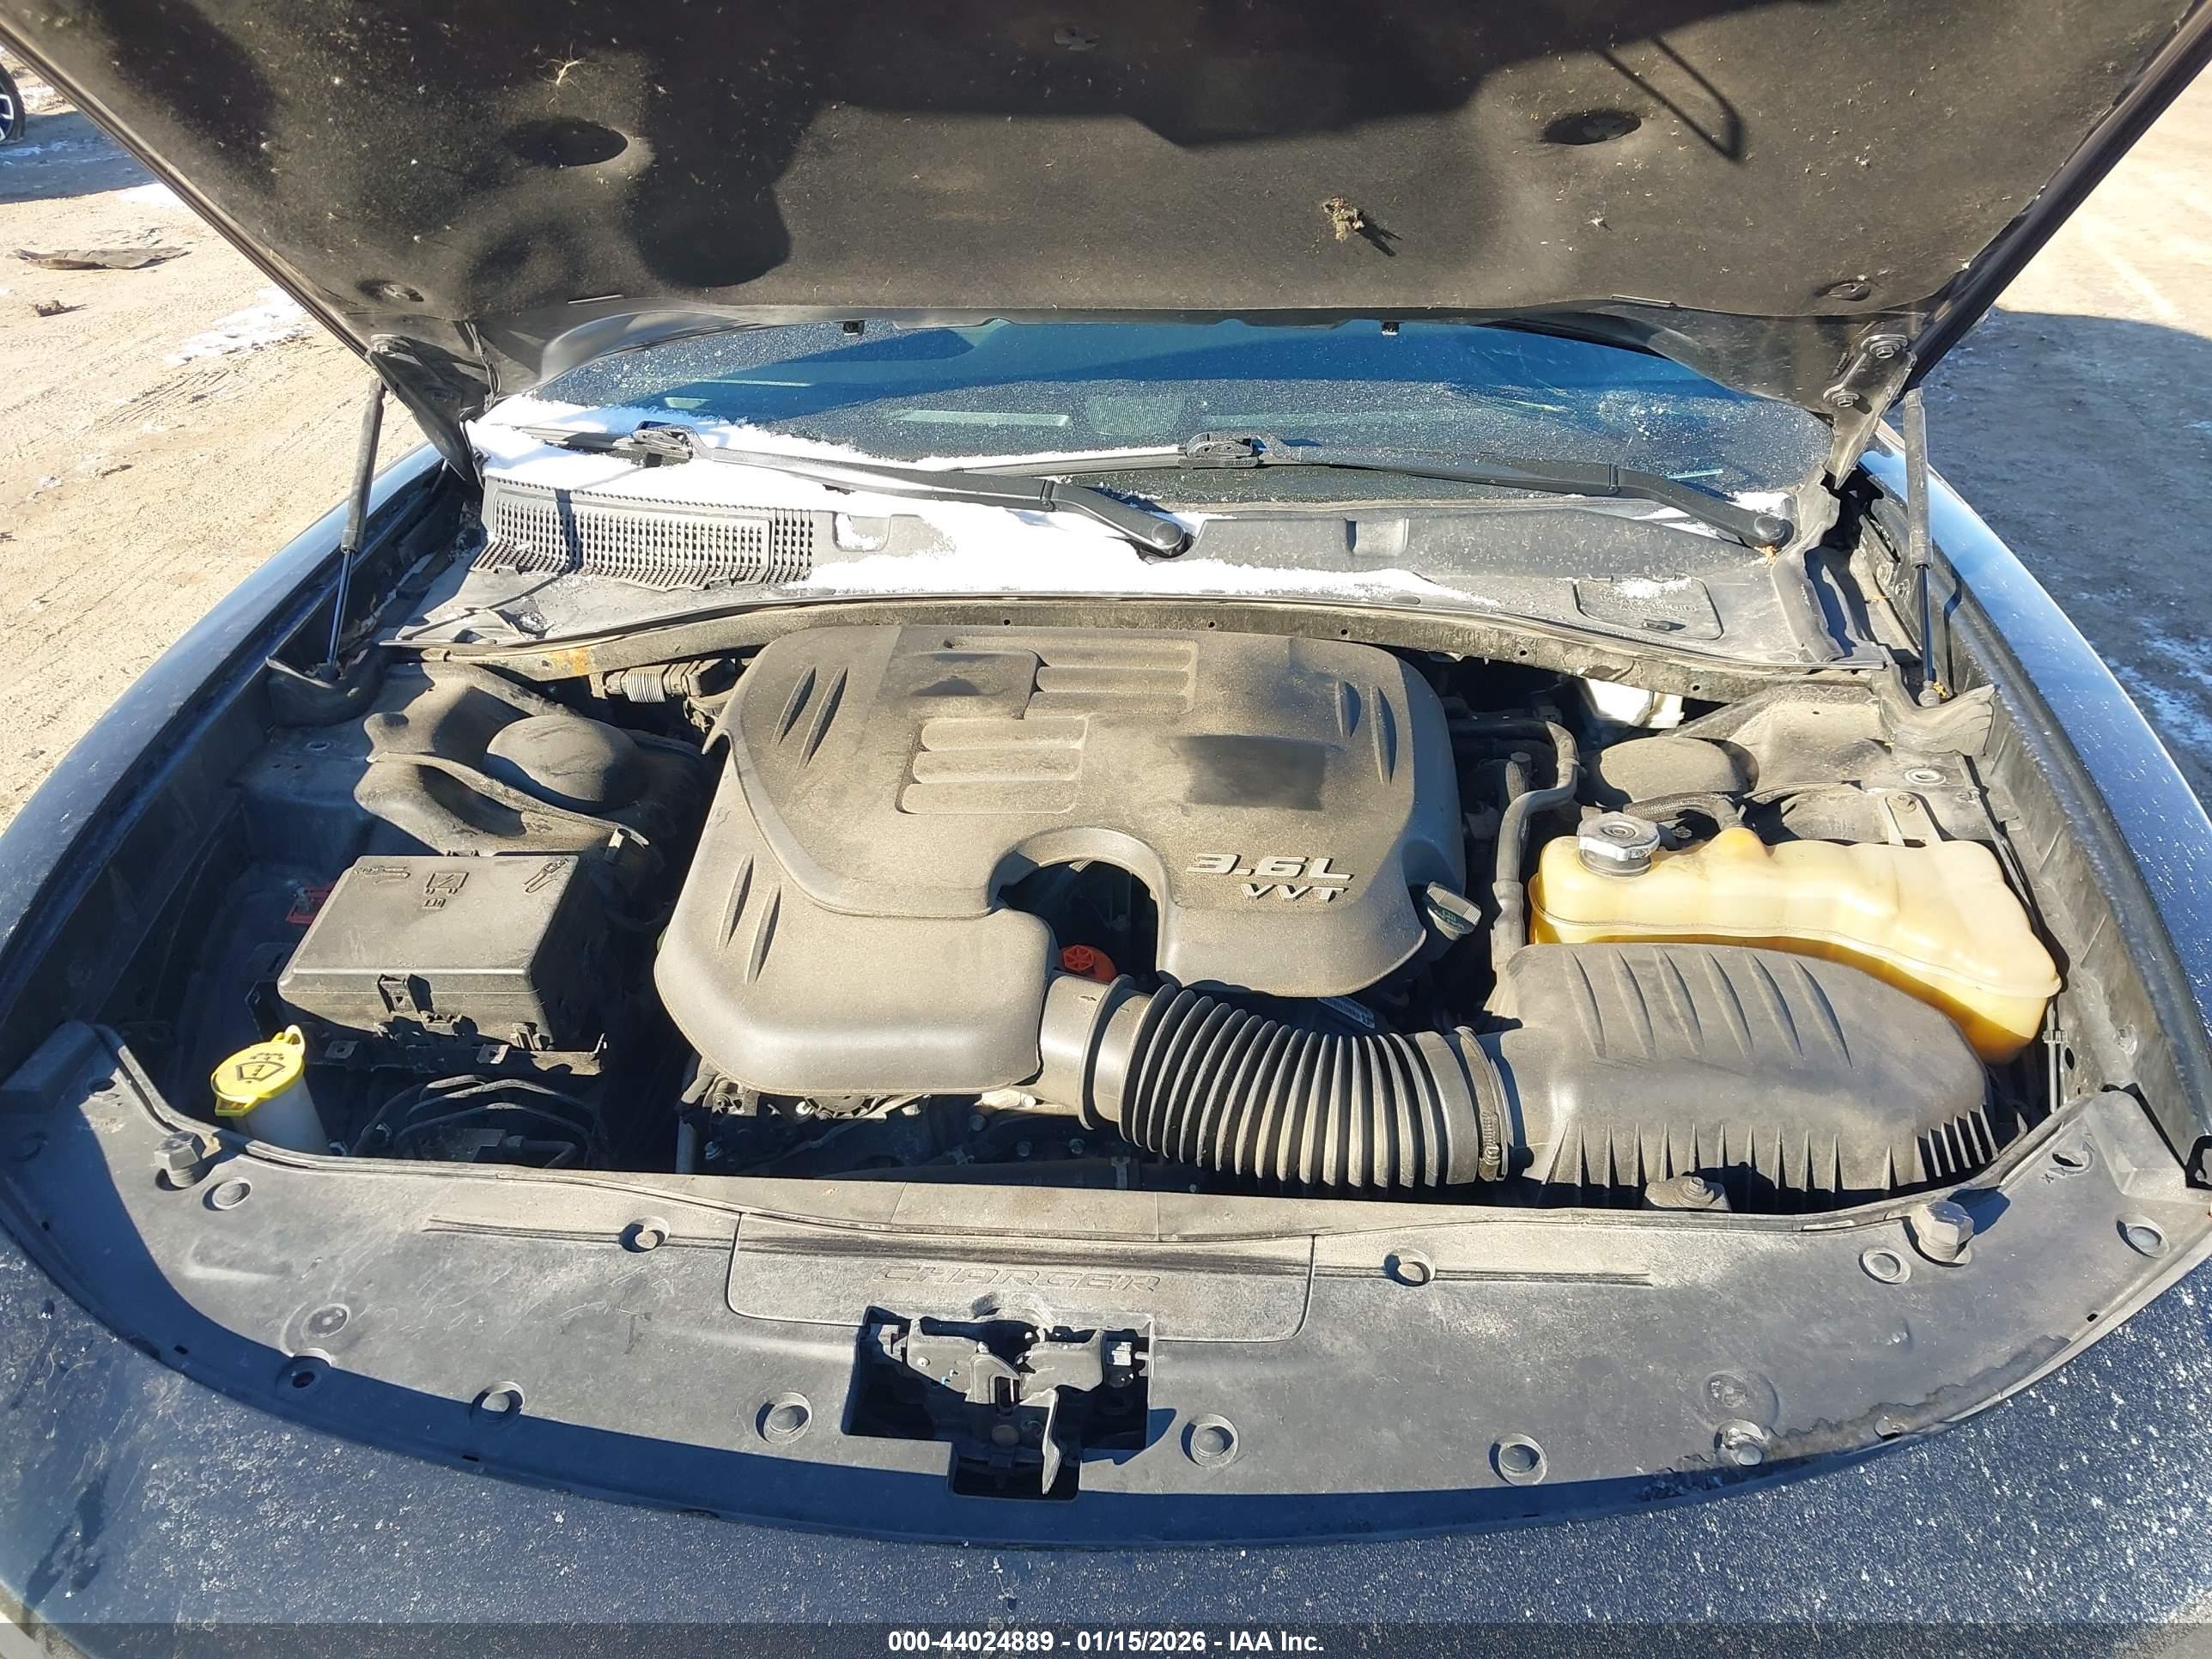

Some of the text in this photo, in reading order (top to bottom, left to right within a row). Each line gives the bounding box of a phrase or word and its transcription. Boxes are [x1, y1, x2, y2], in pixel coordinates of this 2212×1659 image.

[1187, 853, 1354, 880] 3.6L
[1241, 883, 1349, 902] VVT
[871, 1265, 1161, 1291] CHARGER
